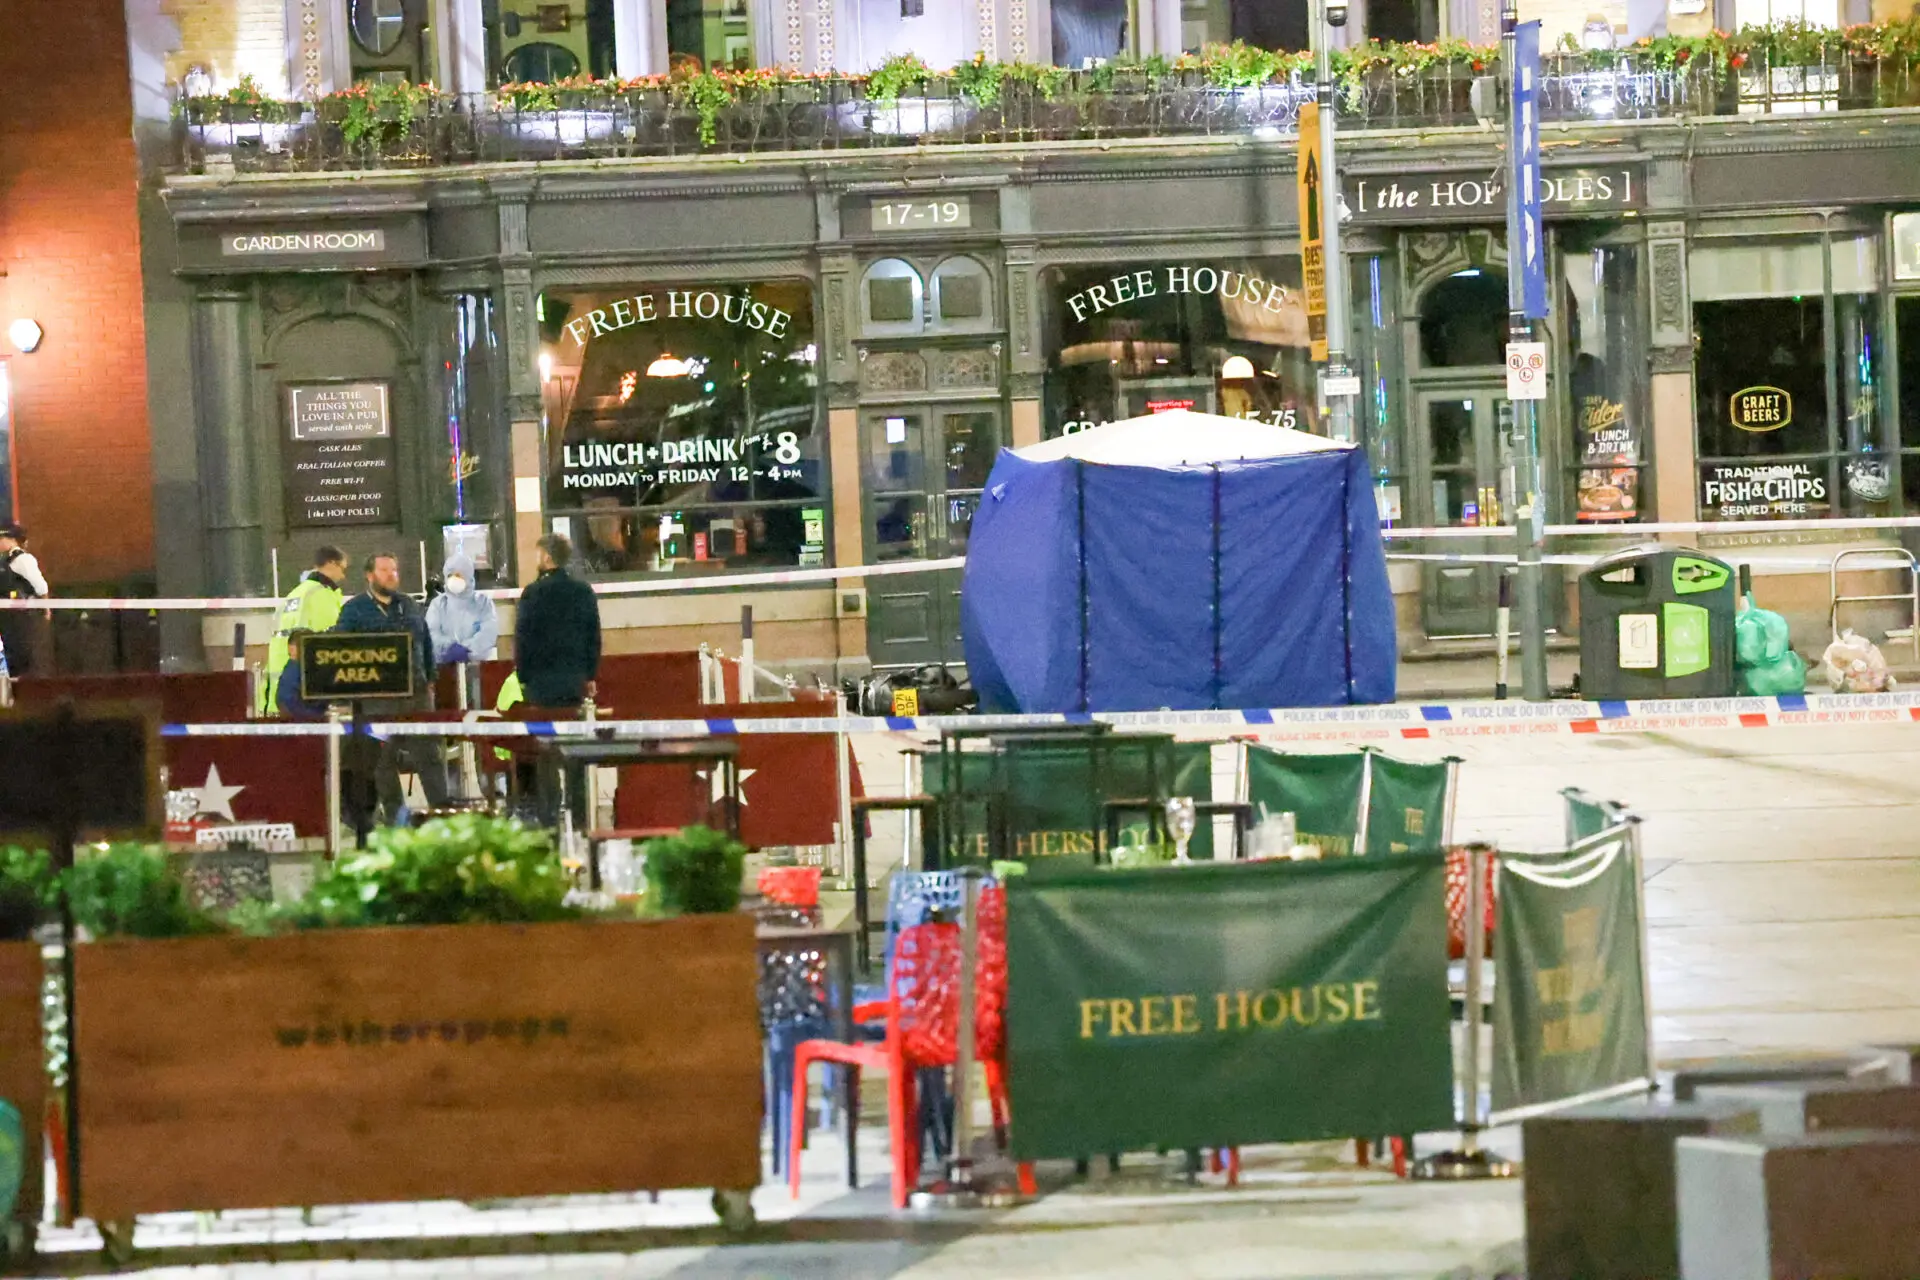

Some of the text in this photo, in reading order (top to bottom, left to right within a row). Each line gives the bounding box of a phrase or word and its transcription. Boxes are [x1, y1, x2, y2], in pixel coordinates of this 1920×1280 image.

[1377, 184, 1418, 207] the
[881, 201, 960, 225] 17-19
[232, 233, 375, 251] GARDEN ROOM
[1066, 270, 1157, 323] FREE
[1166, 266, 1288, 313] HOUSE
[565, 291, 792, 347] FREE HOUSE
[316, 391, 361, 401] ALL THE
[1743, 395, 1779, 409] CRAFT
[306, 401, 371, 411] THINGS YOU
[302, 411, 378, 422] LOVE IN A PUB
[1744, 408, 1780, 422] BEERS
[309, 422, 373, 432] served with style
[1594, 429, 1630, 442] LUNCH
[318, 444, 362, 453] CASK ALES
[563, 443, 644, 468] LUNCH
[662, 438, 739, 464] DRINK
[1587, 440, 1634, 454] & DRINK
[320, 461, 352, 469] ITALIAN
[353, 460, 386, 468] COFFEE
[1714, 464, 1810, 479] TRADITIONAL
[320, 477, 364, 486] FREE WI-FI
[563, 471, 638, 488] MONDAY
[642, 474, 654, 482] TO
[658, 468, 720, 484] FRIDAY
[730, 467, 748, 482] 12
[304, 494, 340, 502] CLASSIC
[327, 509, 346, 517] HOP
[348, 507, 375, 516] POLES
[1721, 502, 1807, 516] SERVED HERE
[315, 648, 397, 665] SMOKING
[334, 667, 380, 683] AREA
[1640, 699, 1767, 714] POLICE LINE DO NOT CROSS
[1819, 695, 1849, 709] POLICE
[1853, 694, 1875, 708] LINE
[1877, 694, 1890, 706] DO
[1893, 693, 1913, 706] NOT
[1462, 703, 1588, 718] POLICE LINE DO NOT CROSS
[1079, 981, 1381, 1040] FREE HOUSE
